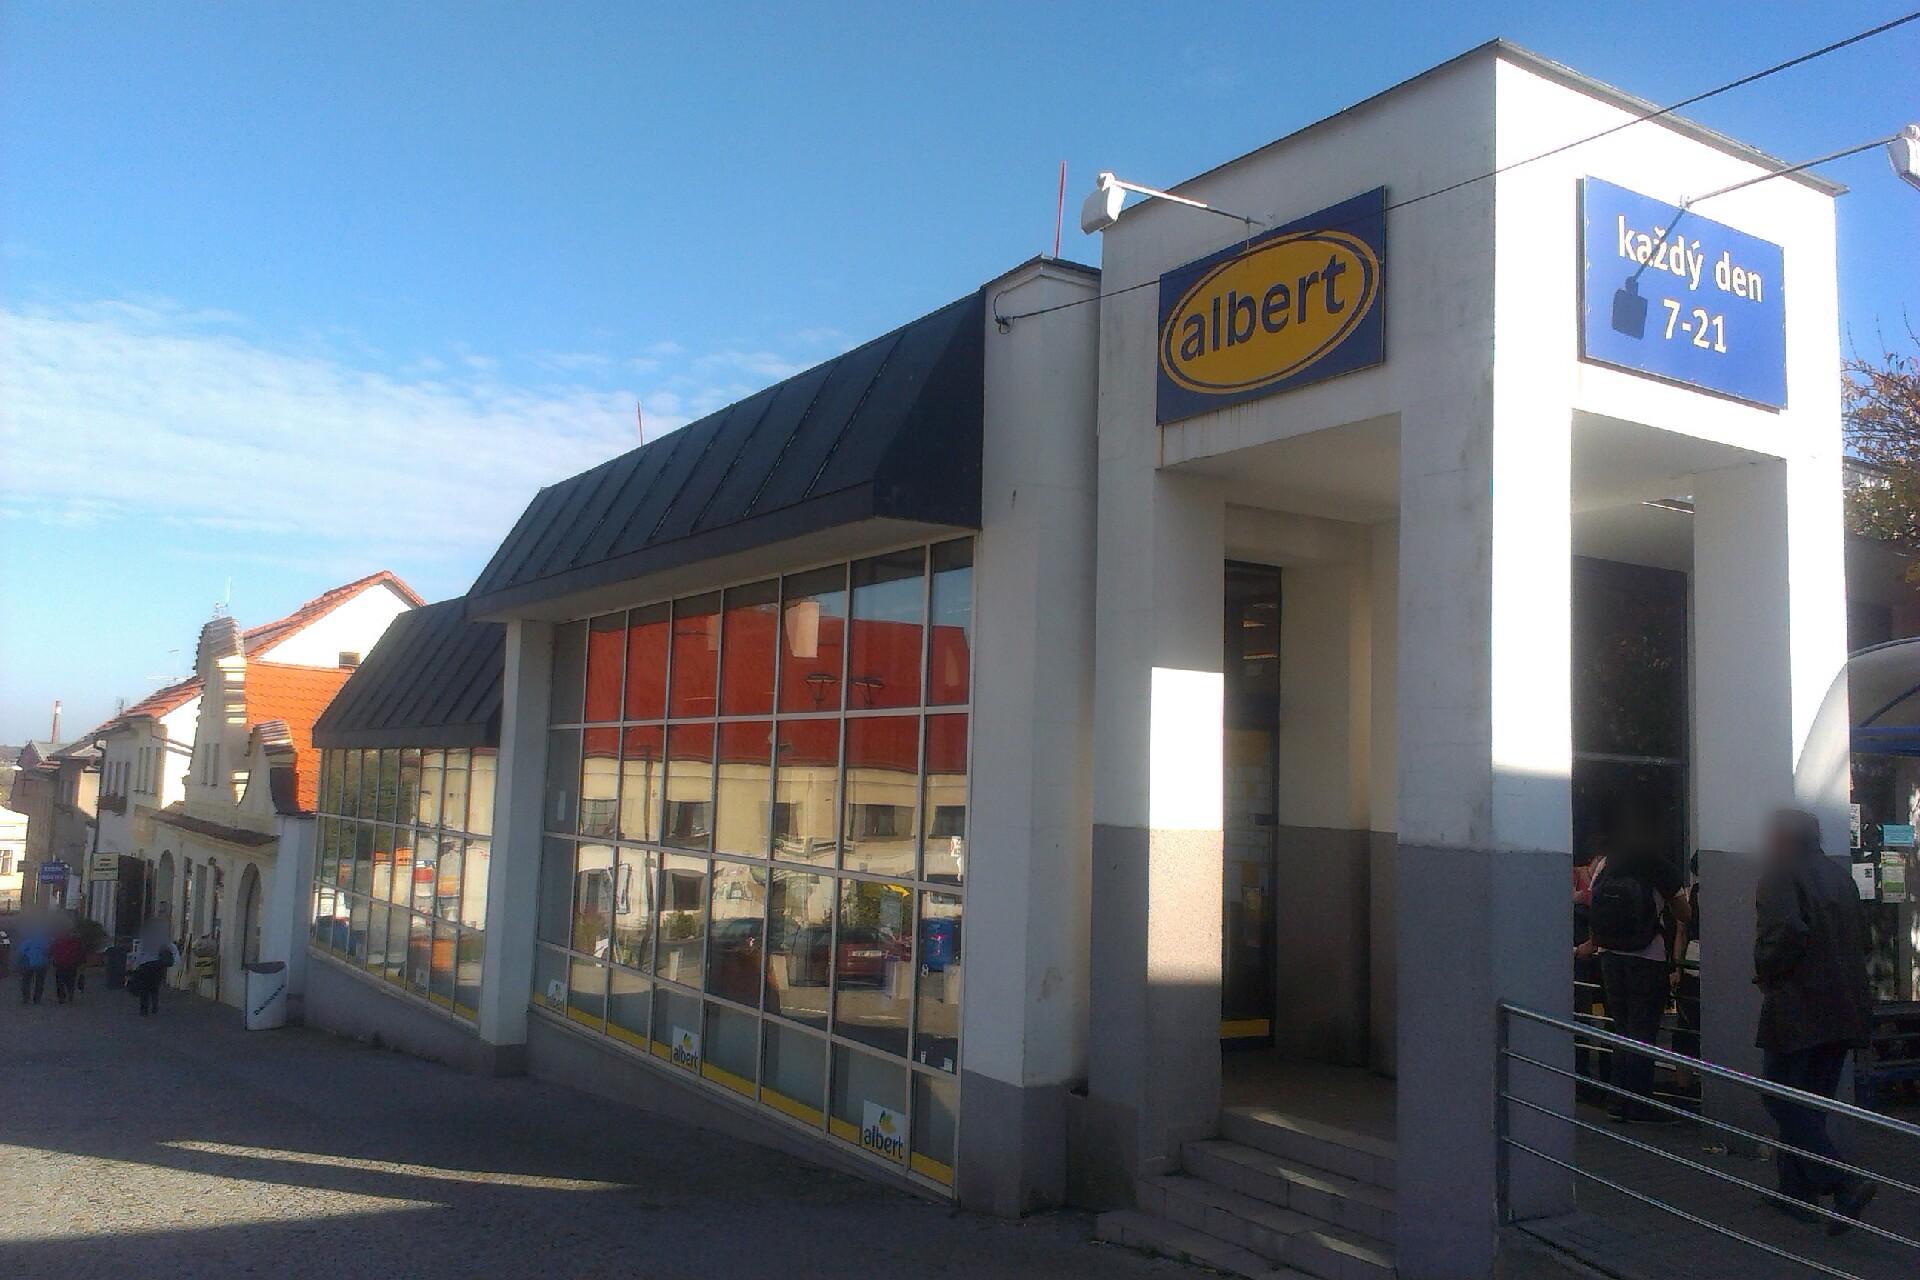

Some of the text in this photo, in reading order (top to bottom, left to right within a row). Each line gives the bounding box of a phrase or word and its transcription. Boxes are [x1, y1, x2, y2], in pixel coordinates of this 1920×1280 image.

[1618, 216, 1762, 303] každý den
[1180, 255, 1346, 361] albert
[1663, 299, 1727, 354] 7-21
[673, 1044, 699, 1069] albert
[863, 1124, 904, 1160] albert
